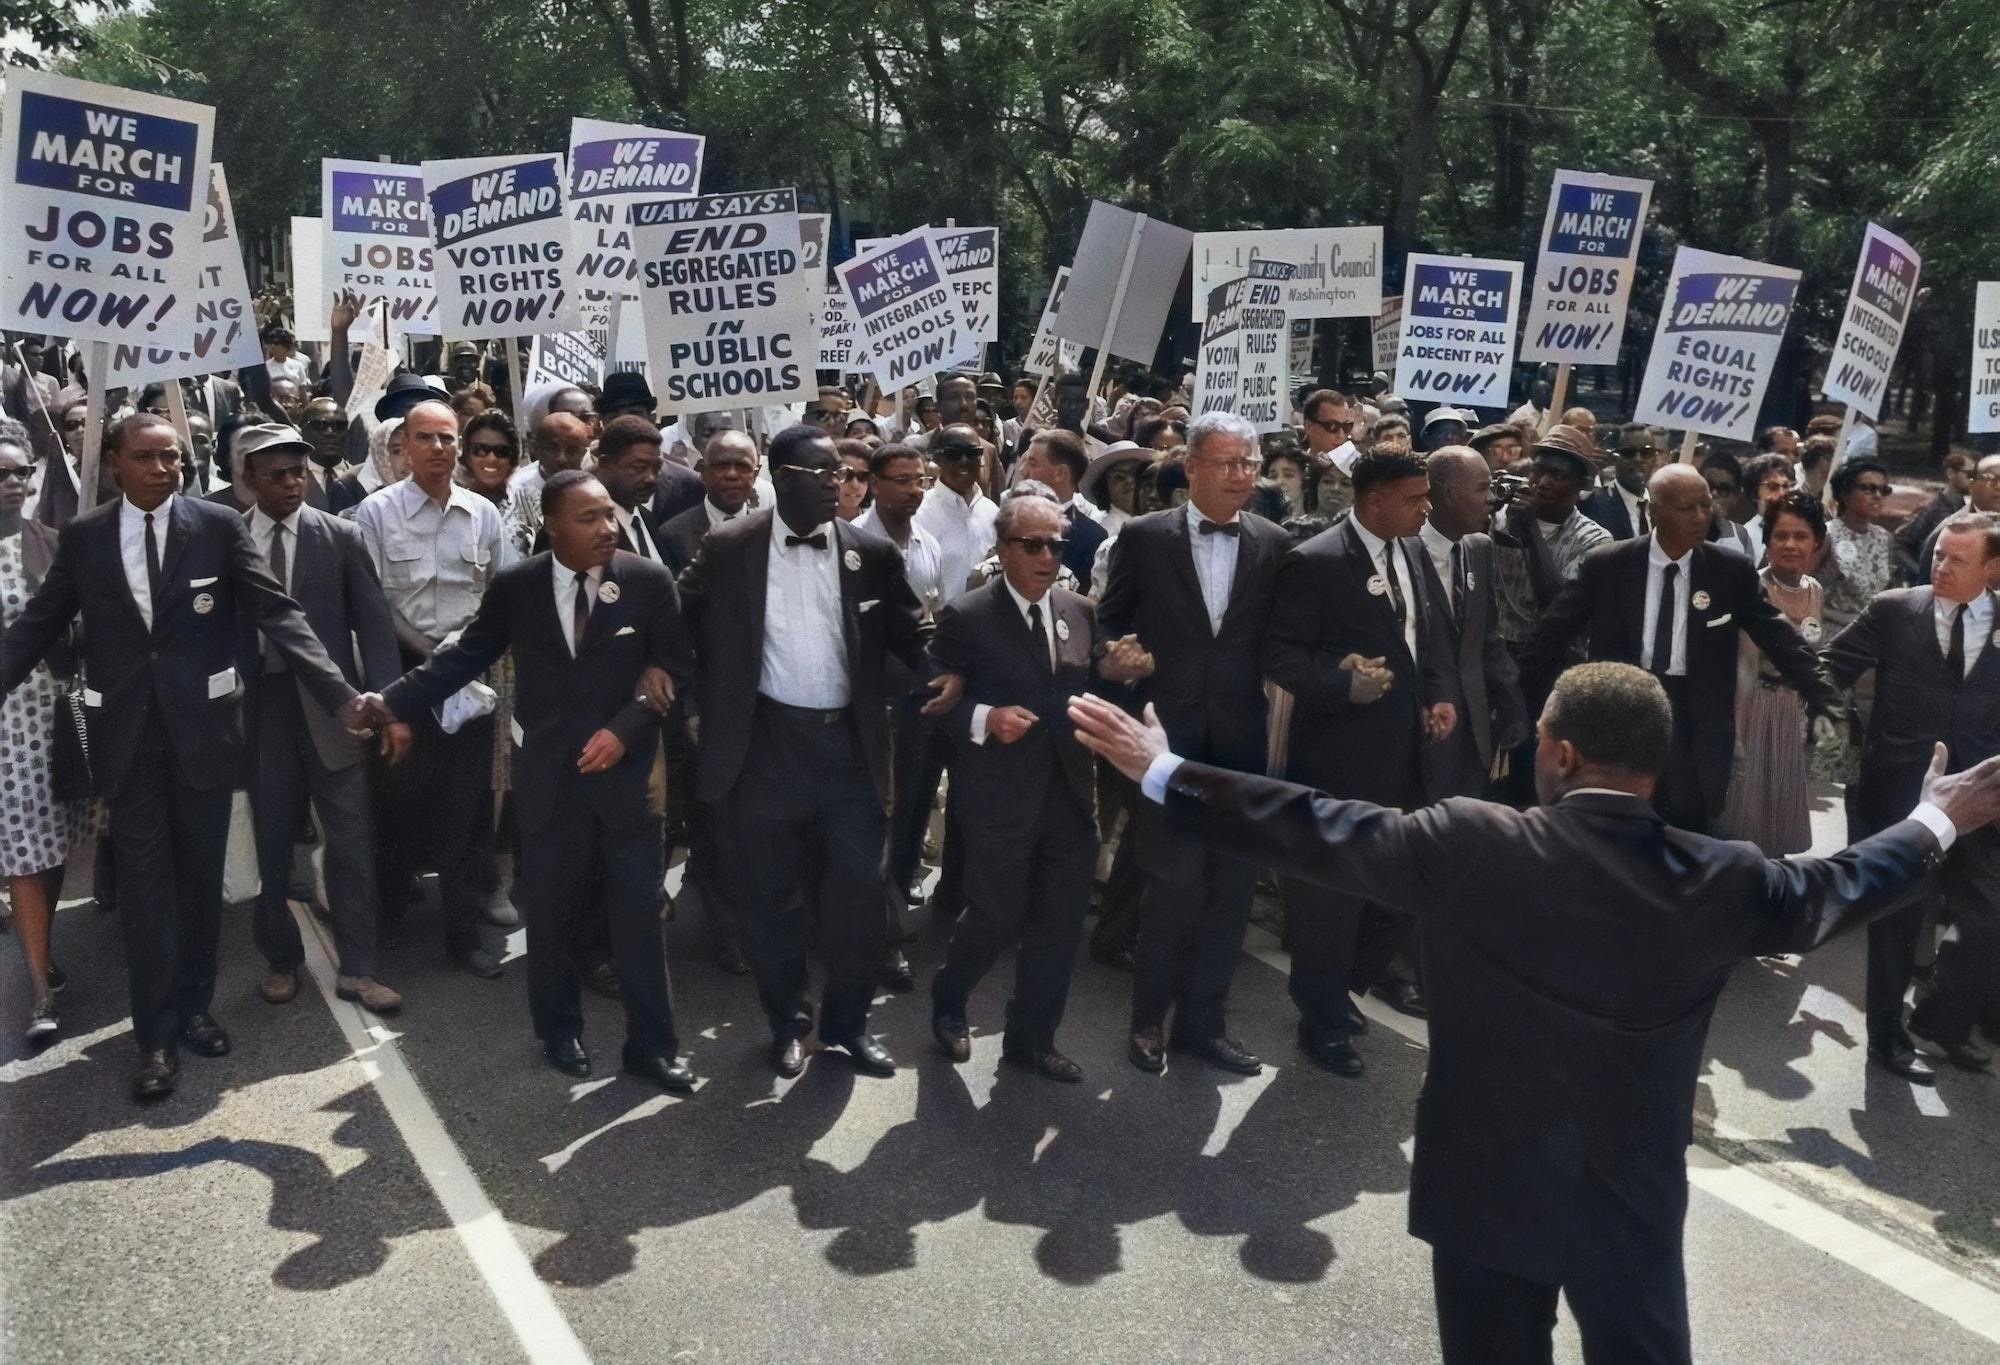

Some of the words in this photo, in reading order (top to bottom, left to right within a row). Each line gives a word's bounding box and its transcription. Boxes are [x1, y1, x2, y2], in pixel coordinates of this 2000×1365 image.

[85, 110, 137, 142] WE
[30, 130, 182, 185] MARCH
[612, 140, 660, 163] WE
[78, 174, 136, 197] FOR
[373, 179, 406, 197] WE
[471, 169, 516, 203] WE
[578, 162, 691, 193] DEMAND
[443, 186, 556, 239] DEMAND
[574, 202, 614, 224] AN
[640, 201, 700, 223] UAW
[706, 192, 791, 217] SAYS:
[1590, 192, 1615, 213] WE
[25, 205, 175, 259] JOBS
[371, 221, 408, 233] FOR
[664, 222, 767, 255] END
[1558, 212, 1632, 240] MARCH
[597, 228, 631, 250] LA
[940, 235, 970, 257] WE
[1578, 239, 1606, 253] FOR
[28, 250, 92, 273] FOR
[110, 263, 166, 284] ALL
[341, 244, 434, 272] JOBS
[447, 241, 564, 269] VOTING
[872, 253, 900, 274] WE
[942, 247, 991, 271] MAND
[1331, 242, 1376, 278] Council
[1888, 252, 1905, 275] WE
[344, 273, 385, 286] FOR
[397, 277, 432, 288] ALL
[644, 249, 797, 288] SEGREGATED
[857, 257, 929, 303] MARCH
[1449, 271, 1478, 287] WE
[1548, 265, 1620, 296] JOBS
[459, 268, 562, 295] RIGHTS
[953, 281, 992, 296] FEPC
[1249, 284, 1280, 304] END
[1714, 277, 1762, 300] WE
[1865, 263, 1908, 308] MARCH
[18, 281, 176, 332] NOW!
[668, 281, 777, 315] RULES
[884, 285, 912, 304] FOR
[1419, 285, 1503, 308] MARCH
[1876, 290, 1893, 310] FOR
[462, 289, 565, 327] NOW!
[590, 315, 609, 325] FO
[864, 289, 947, 337] INTEGRATED
[1241, 308, 1286, 329] SEGREGATED
[1443, 307, 1476, 319] FOR
[1546, 300, 1577, 313] FOR
[1584, 302, 1611, 315] ALL
[1675, 302, 1786, 327] DEMAND
[705, 320, 745, 336] IN
[872, 310, 955, 357] SCHOOLS
[1405, 325, 1443, 339] JOBS
[1446, 328, 1476, 342] FOR
[1478, 330, 1506, 345] ALL
[1535, 321, 1614, 350] NOW!
[1850, 304, 1899, 349] INTEGRATED
[670, 333, 792, 369] PUBLIC
[837, 339, 852, 348] FO
[889, 328, 957, 381] NOW!
[1246, 333, 1277, 354] RULES
[1402, 346, 1414, 358] A
[1416, 346, 1472, 363] DECENT
[1474, 351, 1505, 365] PAY
[1675, 335, 1756, 373] EQUAL
[1842, 332, 1891, 375] SCHOOLS
[1205, 371, 1238, 389] RIGHT
[1254, 362, 1267, 374] IN
[1667, 360, 1755, 398] RIGHTS
[668, 364, 801, 401] SCHOOLS
[1243, 376, 1277, 398] PUBLIC
[1409, 369, 1497, 395] NOW!
[1836, 362, 1882, 403] NOW!
[1241, 401, 1277, 422] SCHOOLS
[1656, 390, 1750, 428] NOW!
